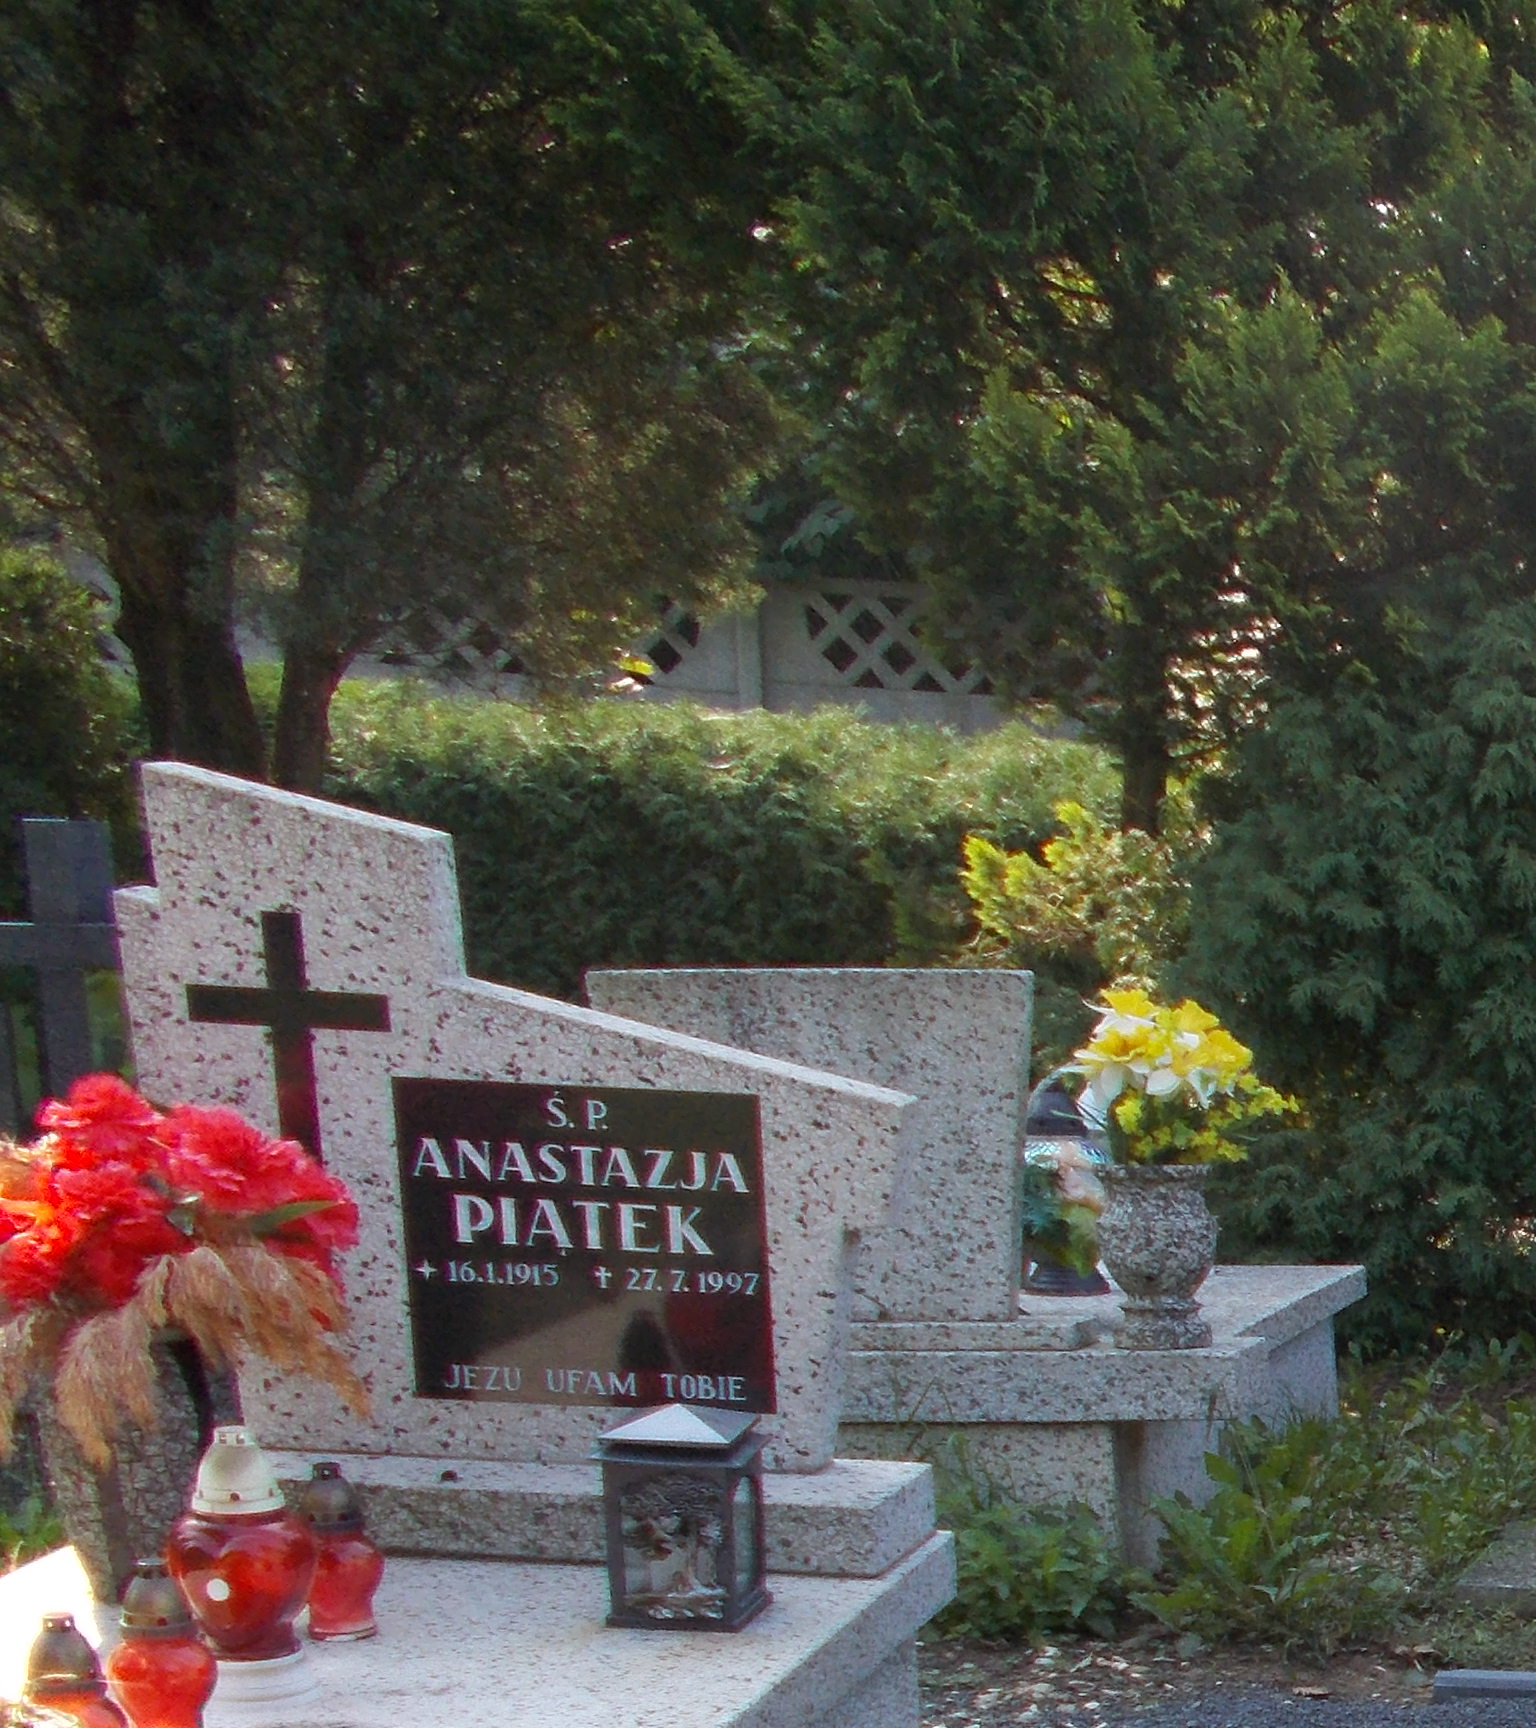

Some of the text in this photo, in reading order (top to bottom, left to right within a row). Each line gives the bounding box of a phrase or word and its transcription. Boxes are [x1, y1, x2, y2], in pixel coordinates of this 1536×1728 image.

[546, 1091, 608, 1131] Ś. P.
[412, 1137, 750, 1193] ANASTAZJA
[453, 1194, 715, 1256] PIĄTEK
[448, 1261, 560, 1287] 16.1.1915
[698, 1272, 760, 1295] 1997
[445, 1365, 747, 1401] JEZU UFAM TOBIE
